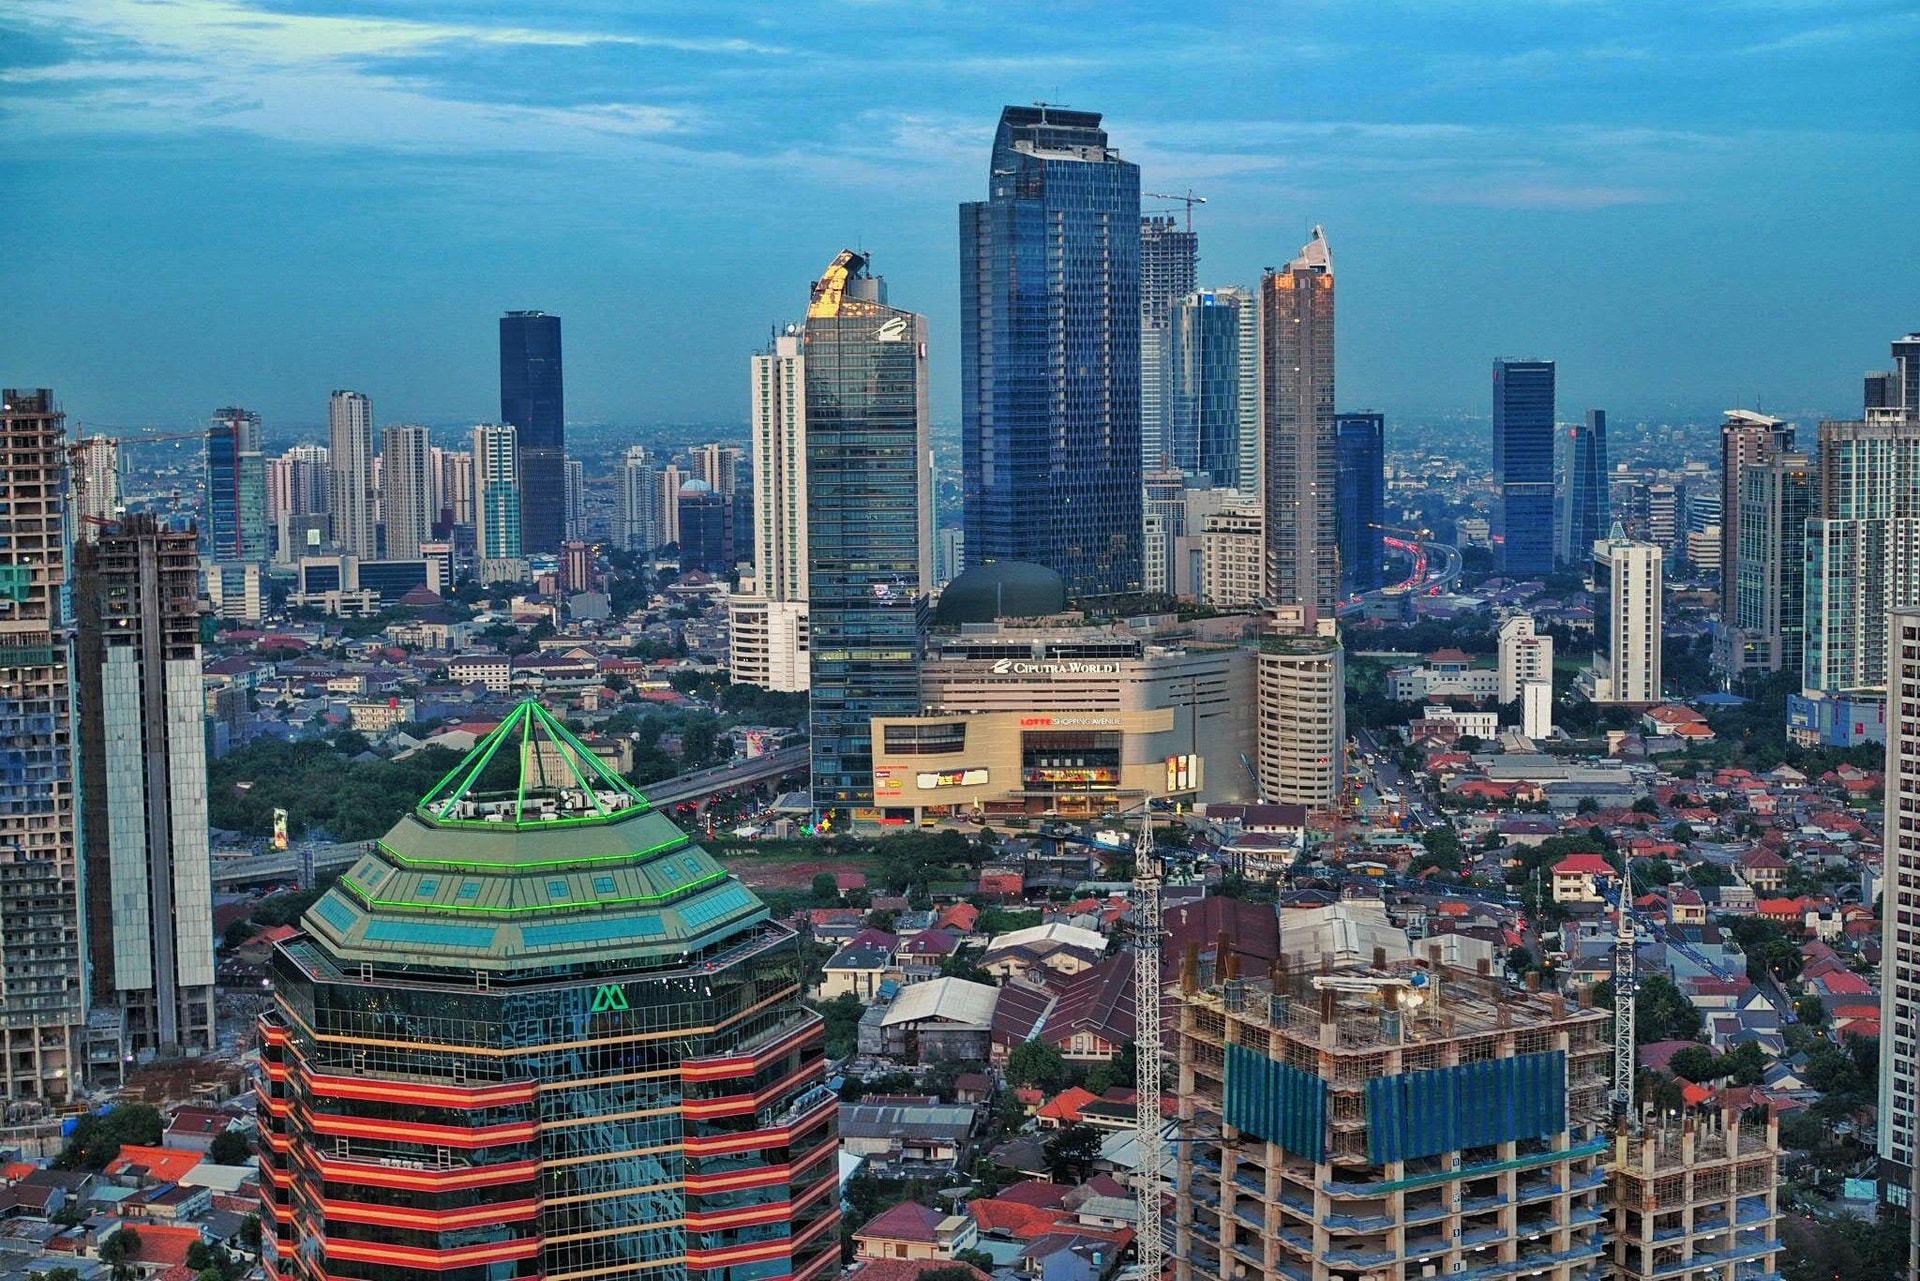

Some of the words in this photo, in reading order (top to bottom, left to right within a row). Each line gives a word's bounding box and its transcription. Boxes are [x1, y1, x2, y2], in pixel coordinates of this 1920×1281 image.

[1013, 662, 1066, 674] CIPUTRA
[1068, 662, 1112, 674] WORLD
[1020, 718, 1052, 726] LOTTE
[1053, 717, 1091, 726] SHOPPING
[1092, 718, 1122, 726] AVENUE
